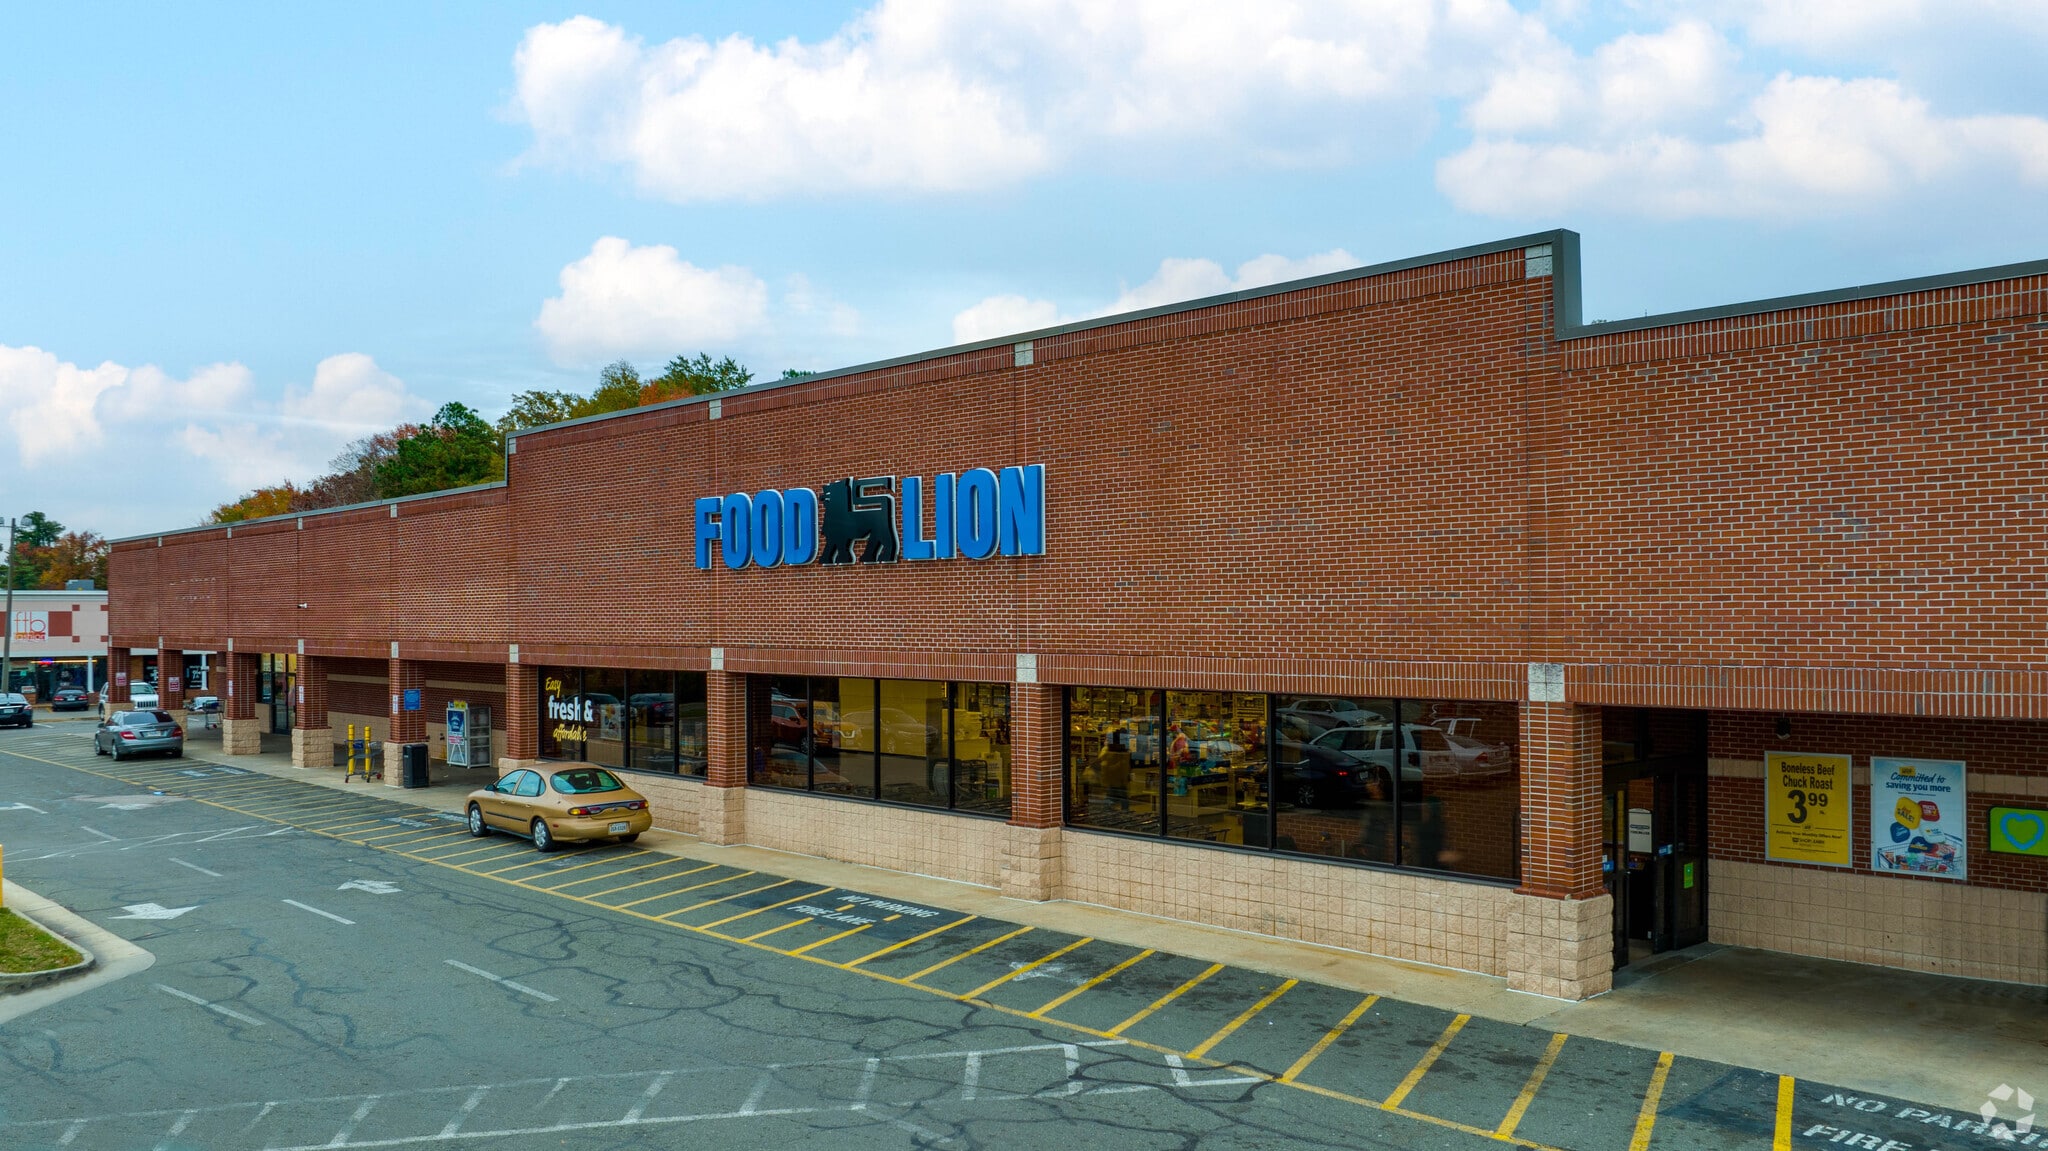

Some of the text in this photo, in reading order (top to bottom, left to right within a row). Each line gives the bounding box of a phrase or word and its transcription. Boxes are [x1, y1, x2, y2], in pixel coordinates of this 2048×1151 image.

[695, 463, 1045, 570] FOOD LION
[545, 677, 561, 698] Easy
[548, 695, 593, 722] fresh &
[553, 723, 587, 742] affordabe
[1781, 762, 1835, 775] Boneless Beef
[1783, 775, 1833, 790] Chuck Roast
[1886, 781, 1951, 793] saving you more
[1890, 772, 1947, 784] Committed to
[860, 900, 940, 918] PARKING
[822, 912, 877, 926] LANE
[1821, 1093, 1887, 1112] NO
[1803, 1124, 1912, 1151] FIRE
